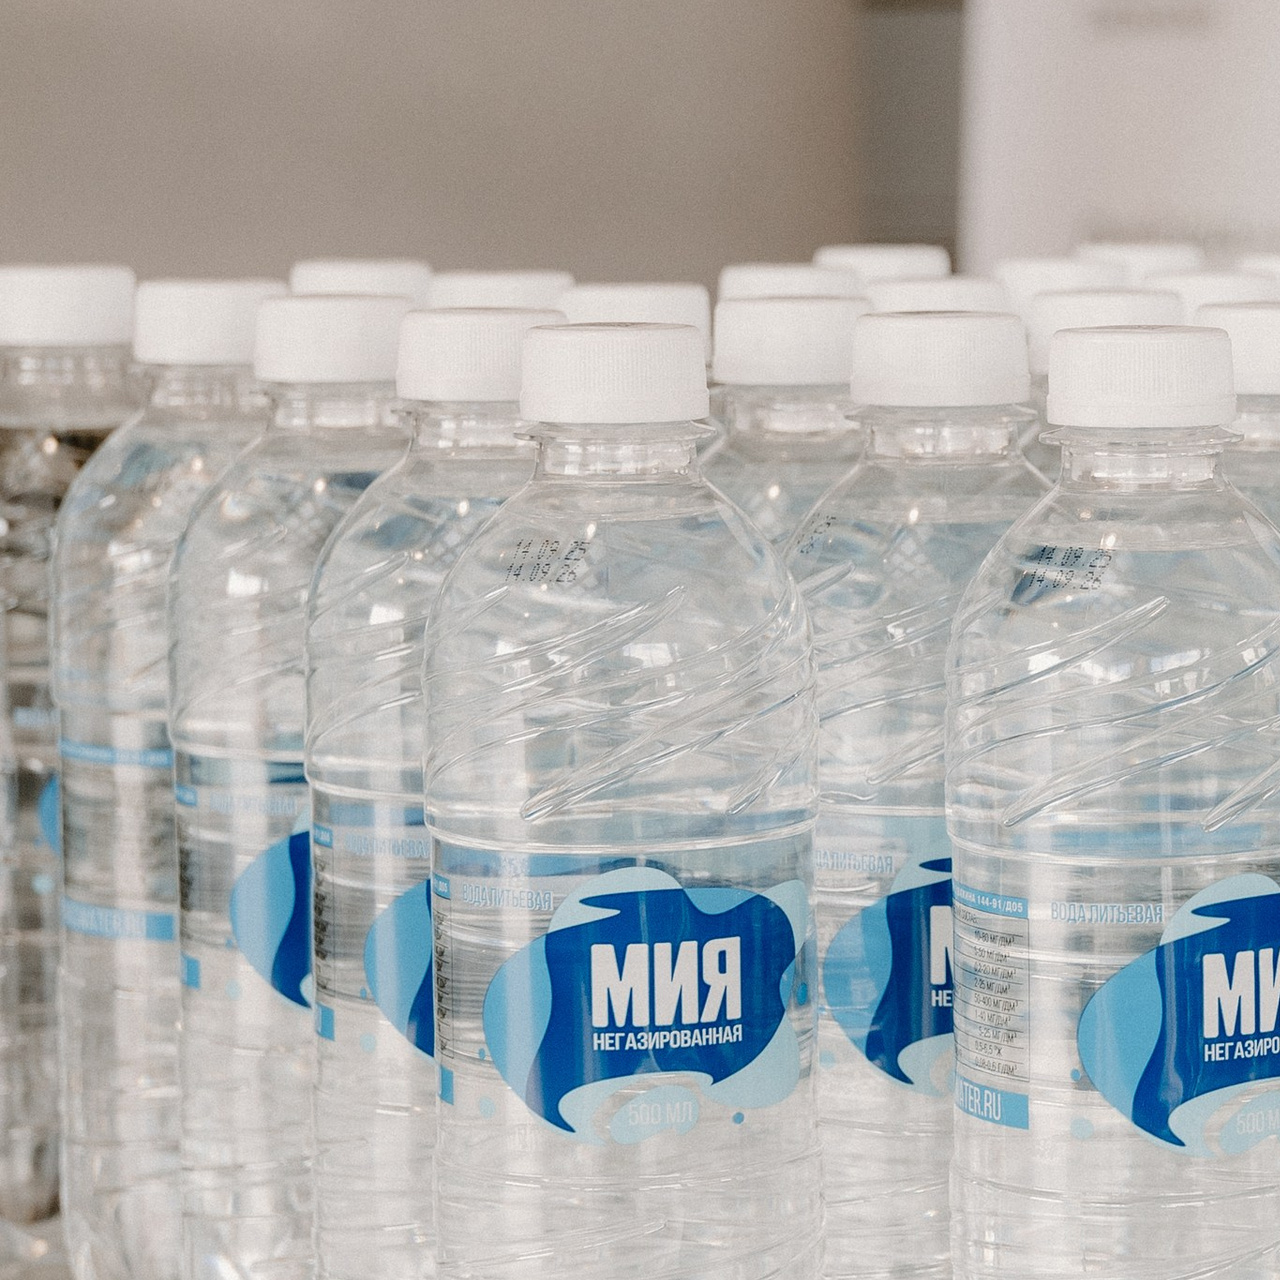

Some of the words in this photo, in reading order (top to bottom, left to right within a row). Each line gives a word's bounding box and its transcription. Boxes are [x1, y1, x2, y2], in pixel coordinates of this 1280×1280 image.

[514, 539, 590, 561] 14.09.25
[1037, 545, 1116, 568] 14.09.25
[505, 563, 580, 582] 14.09.26
[1029, 569, 1105, 590] 14.09.26
[462, 883, 488, 907] ВОДА
[489, 887, 554, 911] ПИТЬЕВАЯ
[1051, 901, 1086, 924] ВОДА
[1089, 903, 1164, 924] ПИТЬЕВАЯ
[590, 936, 742, 1028] МИЯ
[593, 1025, 743, 1051] НЕГАЗИРОВАННАЯ
[629, 1103, 661, 1125] 500
[666, 1101, 693, 1123] МЛ
[1237, 1110, 1265, 1135] 500
